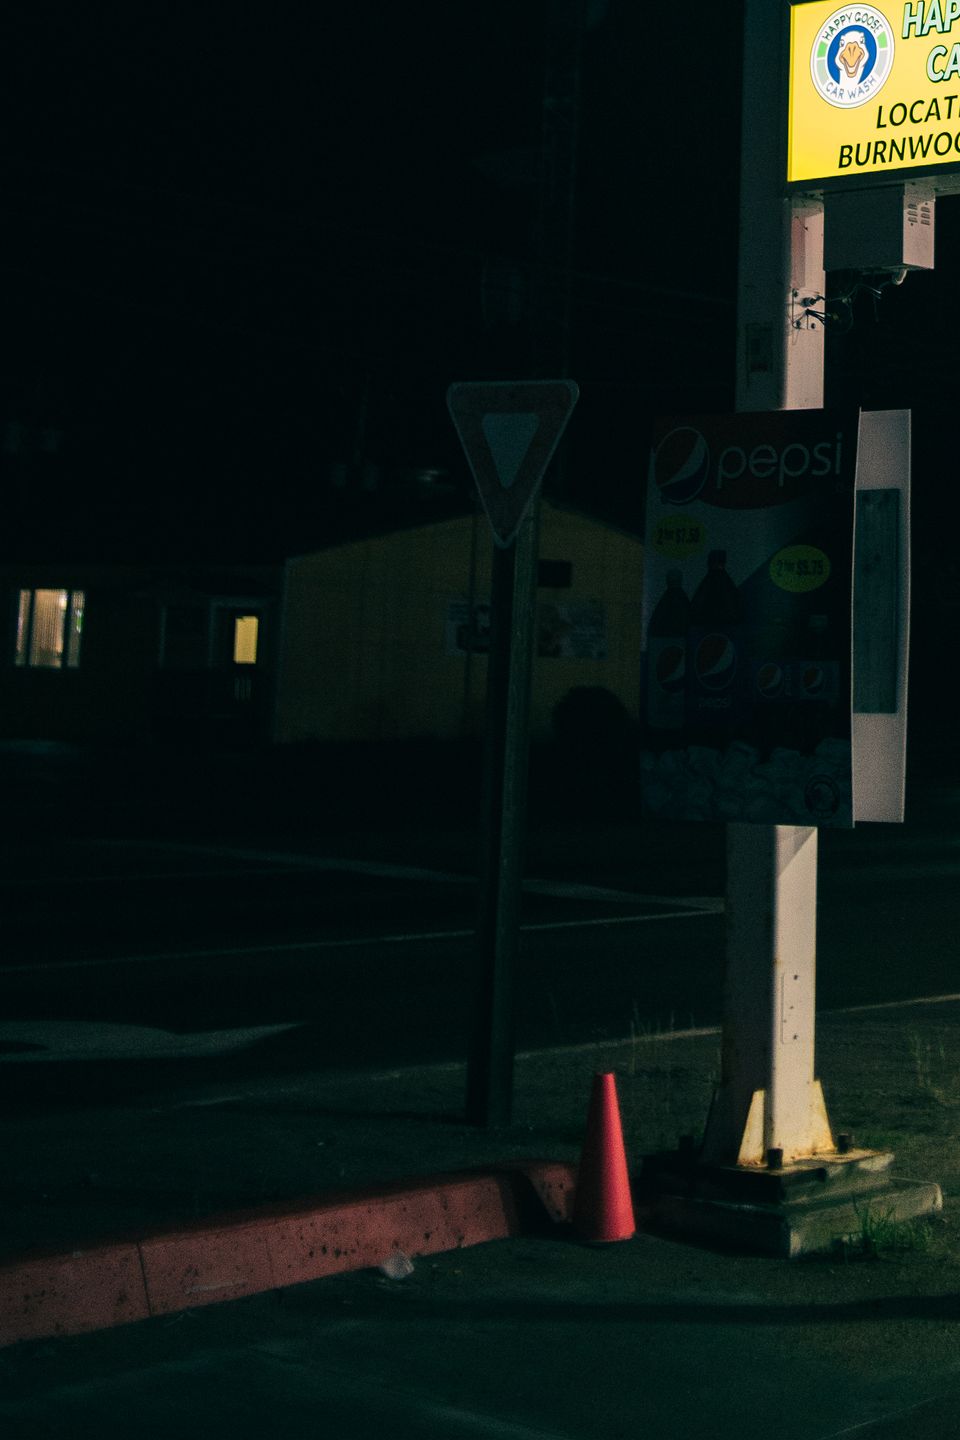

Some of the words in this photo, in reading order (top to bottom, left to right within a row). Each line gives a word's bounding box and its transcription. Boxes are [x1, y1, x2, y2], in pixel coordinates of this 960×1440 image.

[822, 12, 853, 40] HAPPY
[854, 11, 883, 34] GOOSE
[826, 81, 845, 100] CAR
[847, 75, 877, 100] WASH
[716, 431, 843, 490] pepsi
